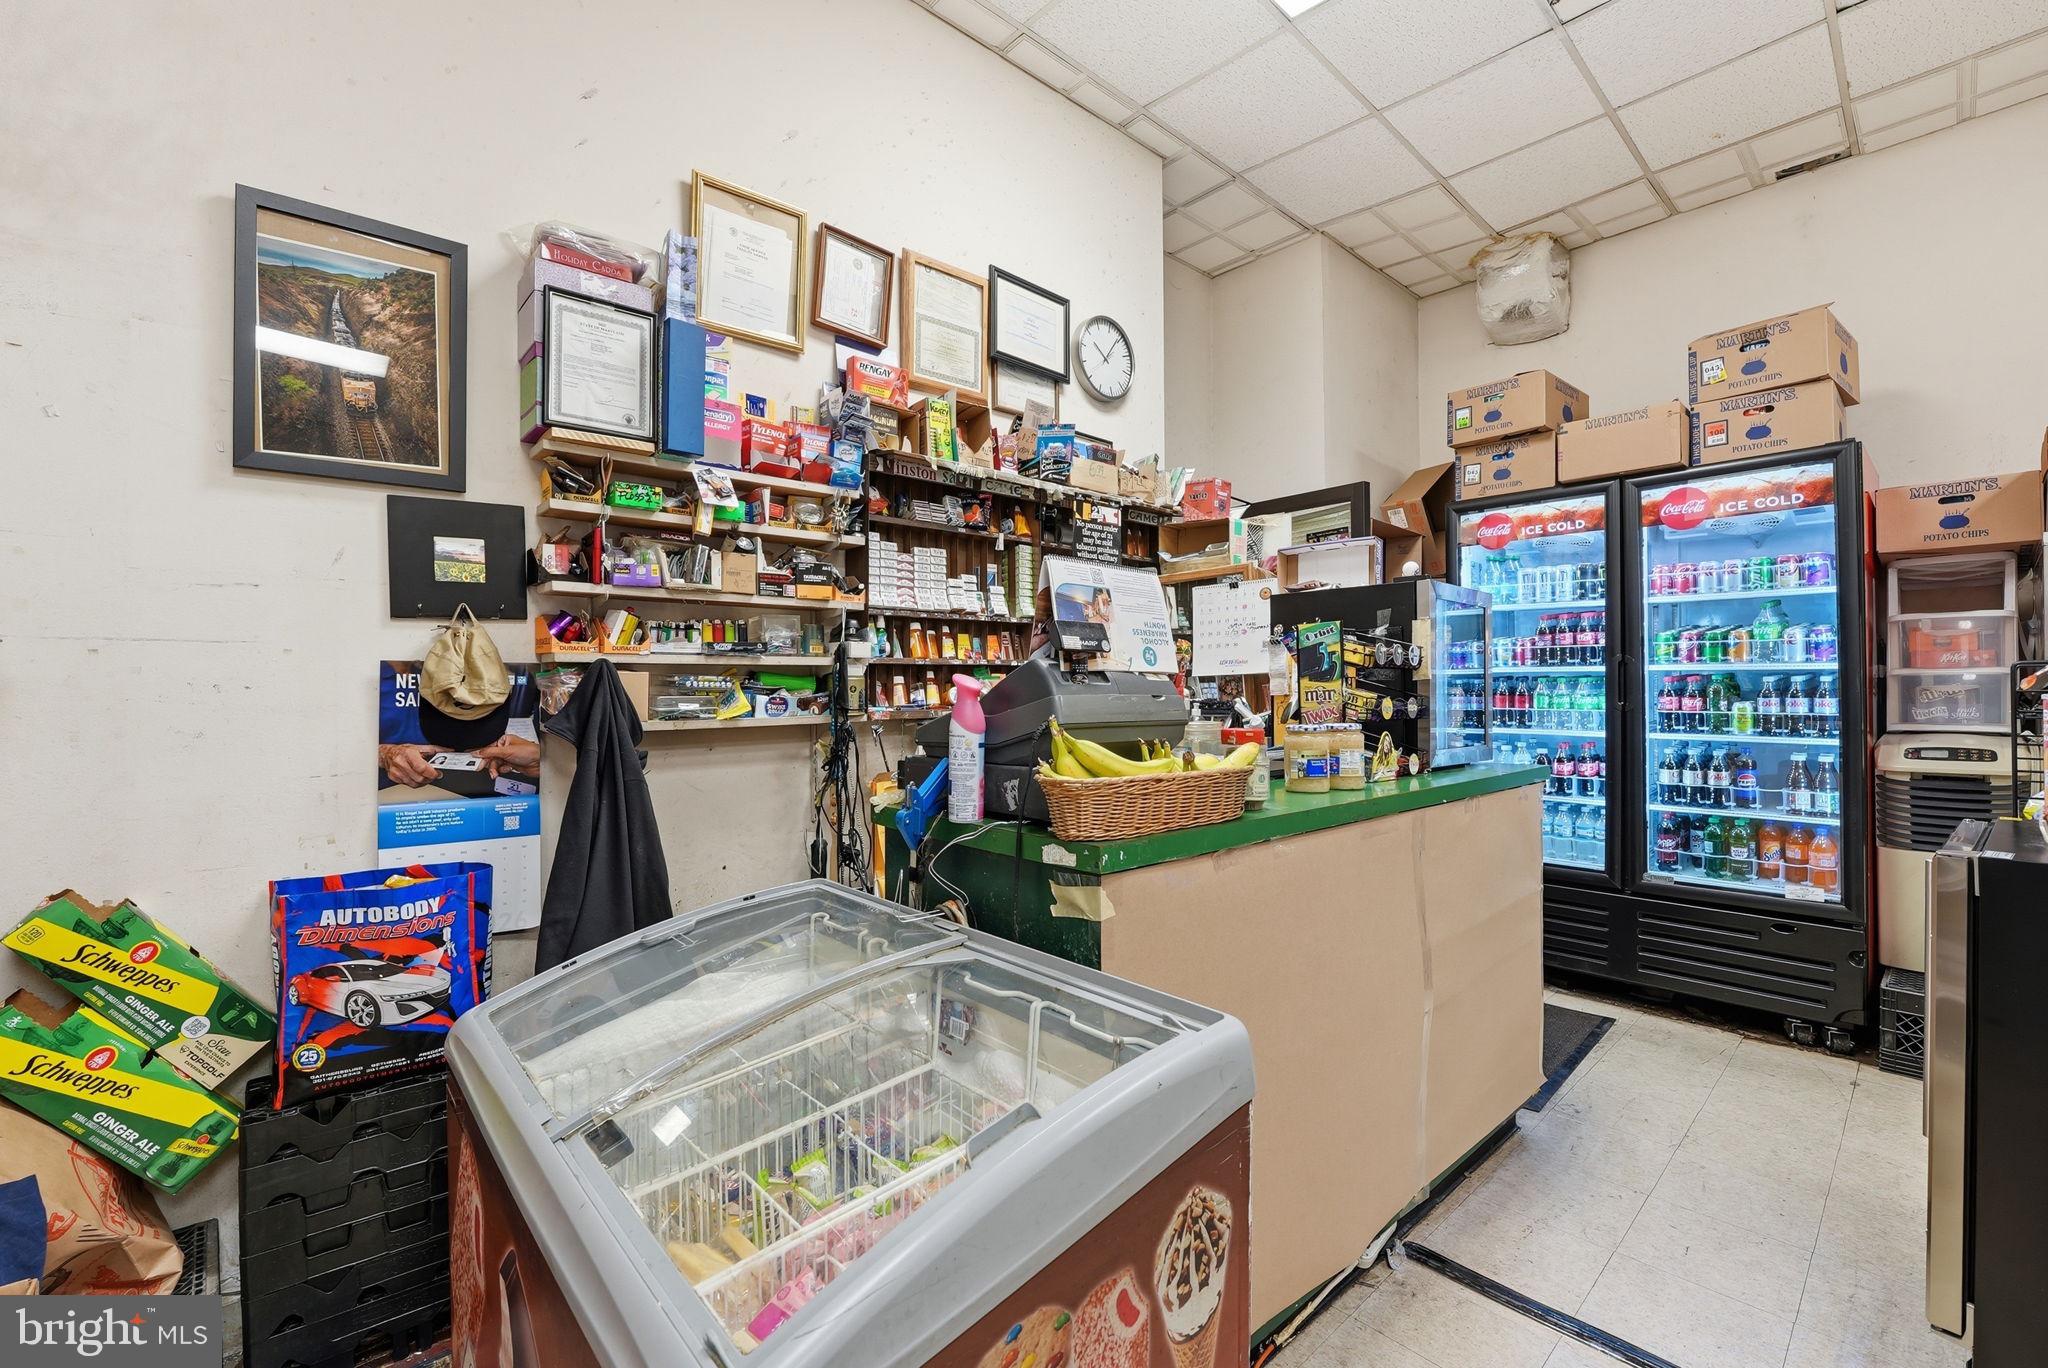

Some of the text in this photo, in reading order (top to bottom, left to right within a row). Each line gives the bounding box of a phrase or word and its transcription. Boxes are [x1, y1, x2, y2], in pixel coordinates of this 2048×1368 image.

[554, 249, 588, 267] HOLIDAY
[1716, 320, 1791, 350] MARTIN'S
[859, 362, 893, 378] BENGAY
[1466, 378, 1520, 400] MARTIN'S
[1728, 371, 1783, 390] POTATO CHIPS
[1720, 388, 1798, 412] MARTIN'S
[704, 409, 733, 421] enadryl
[1585, 407, 1649, 430] MARTIN'S
[751, 423, 788, 442] TYLENOL
[1475, 421, 1513, 435] POTATO CHIPS
[1732, 437, 1788, 454] POTATO CHIPS
[1909, 477, 2002, 500] MARTIN'S
[1661, 493, 1805, 517] Coca-Cola ICE COLD
[1477, 519, 1586, 538] Coca-Cola ICE COLD
[1923, 529, 1990, 543] POTATO CHIPS
[1076, 543, 1119, 555] tobacco products
[1083, 537, 1094, 545] may
[1077, 550, 1098, 560] without
[1304, 624, 1337, 642] Orbit
[319, 896, 442, 927] AUTOBODY
[296, 911, 457, 946] Dimensions
[60, 943, 181, 996] Schweppes
[124, 995, 176, 1034] GINGER ALE
[207, 1039, 231, 1057] Scan
[300, 1050, 318, 1063] 25
[186, 1050, 225, 1079] TOPGOLF
[8, 1054, 141, 1101] Schweppes
[92, 1110, 141, 1144] GINGER
[135, 1137, 162, 1156] ALE
